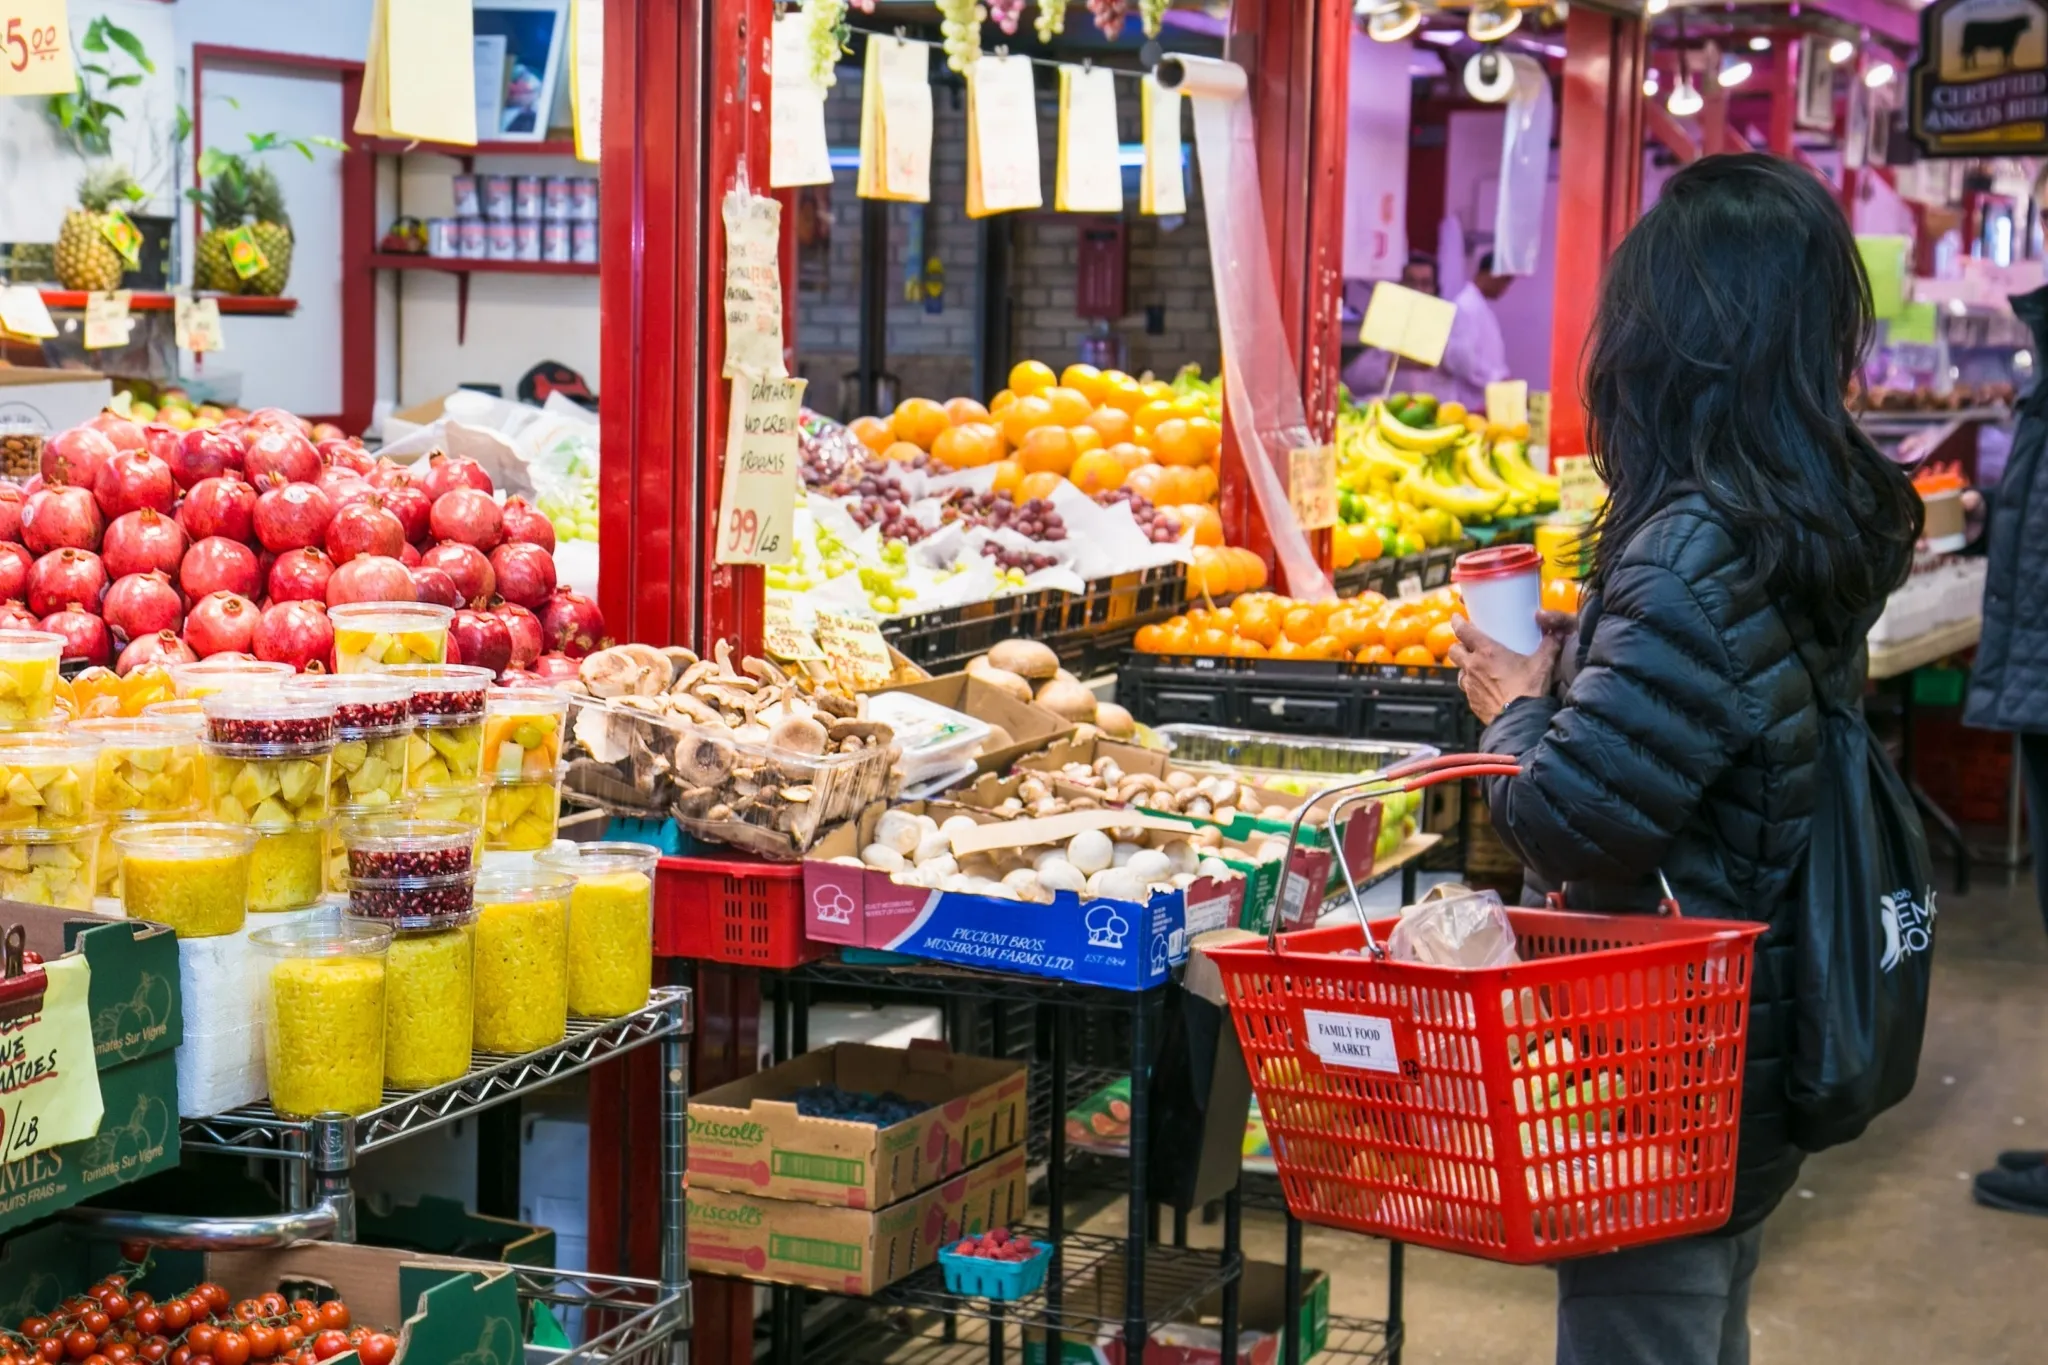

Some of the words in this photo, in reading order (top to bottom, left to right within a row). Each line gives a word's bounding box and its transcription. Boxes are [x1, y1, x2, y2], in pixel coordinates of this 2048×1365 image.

[1925, 104, 2003, 131] ANGUS
[952, 927, 1007, 945] PICCIONI
[1008, 936, 1045, 951] BROS.
[923, 937, 1000, 959] MUSHROOM
[998, 949, 1043, 964] FARMS
[1044, 956, 1074, 971] LTD.
[124, 1031, 141, 1047] Sur
[142, 1023, 167, 1042] Vigne
[1318, 1023, 1353, 1038] FAMILY
[1354, 1028, 1380, 1041] FOOD
[1332, 1041, 1372, 1058] MARKET
[82, 1161, 120, 1184] Tomates
[121, 1154, 138, 1169] Sur
[138, 1143, 165, 1163] Vigne
[28, 1182, 55, 1204] FRAIS
